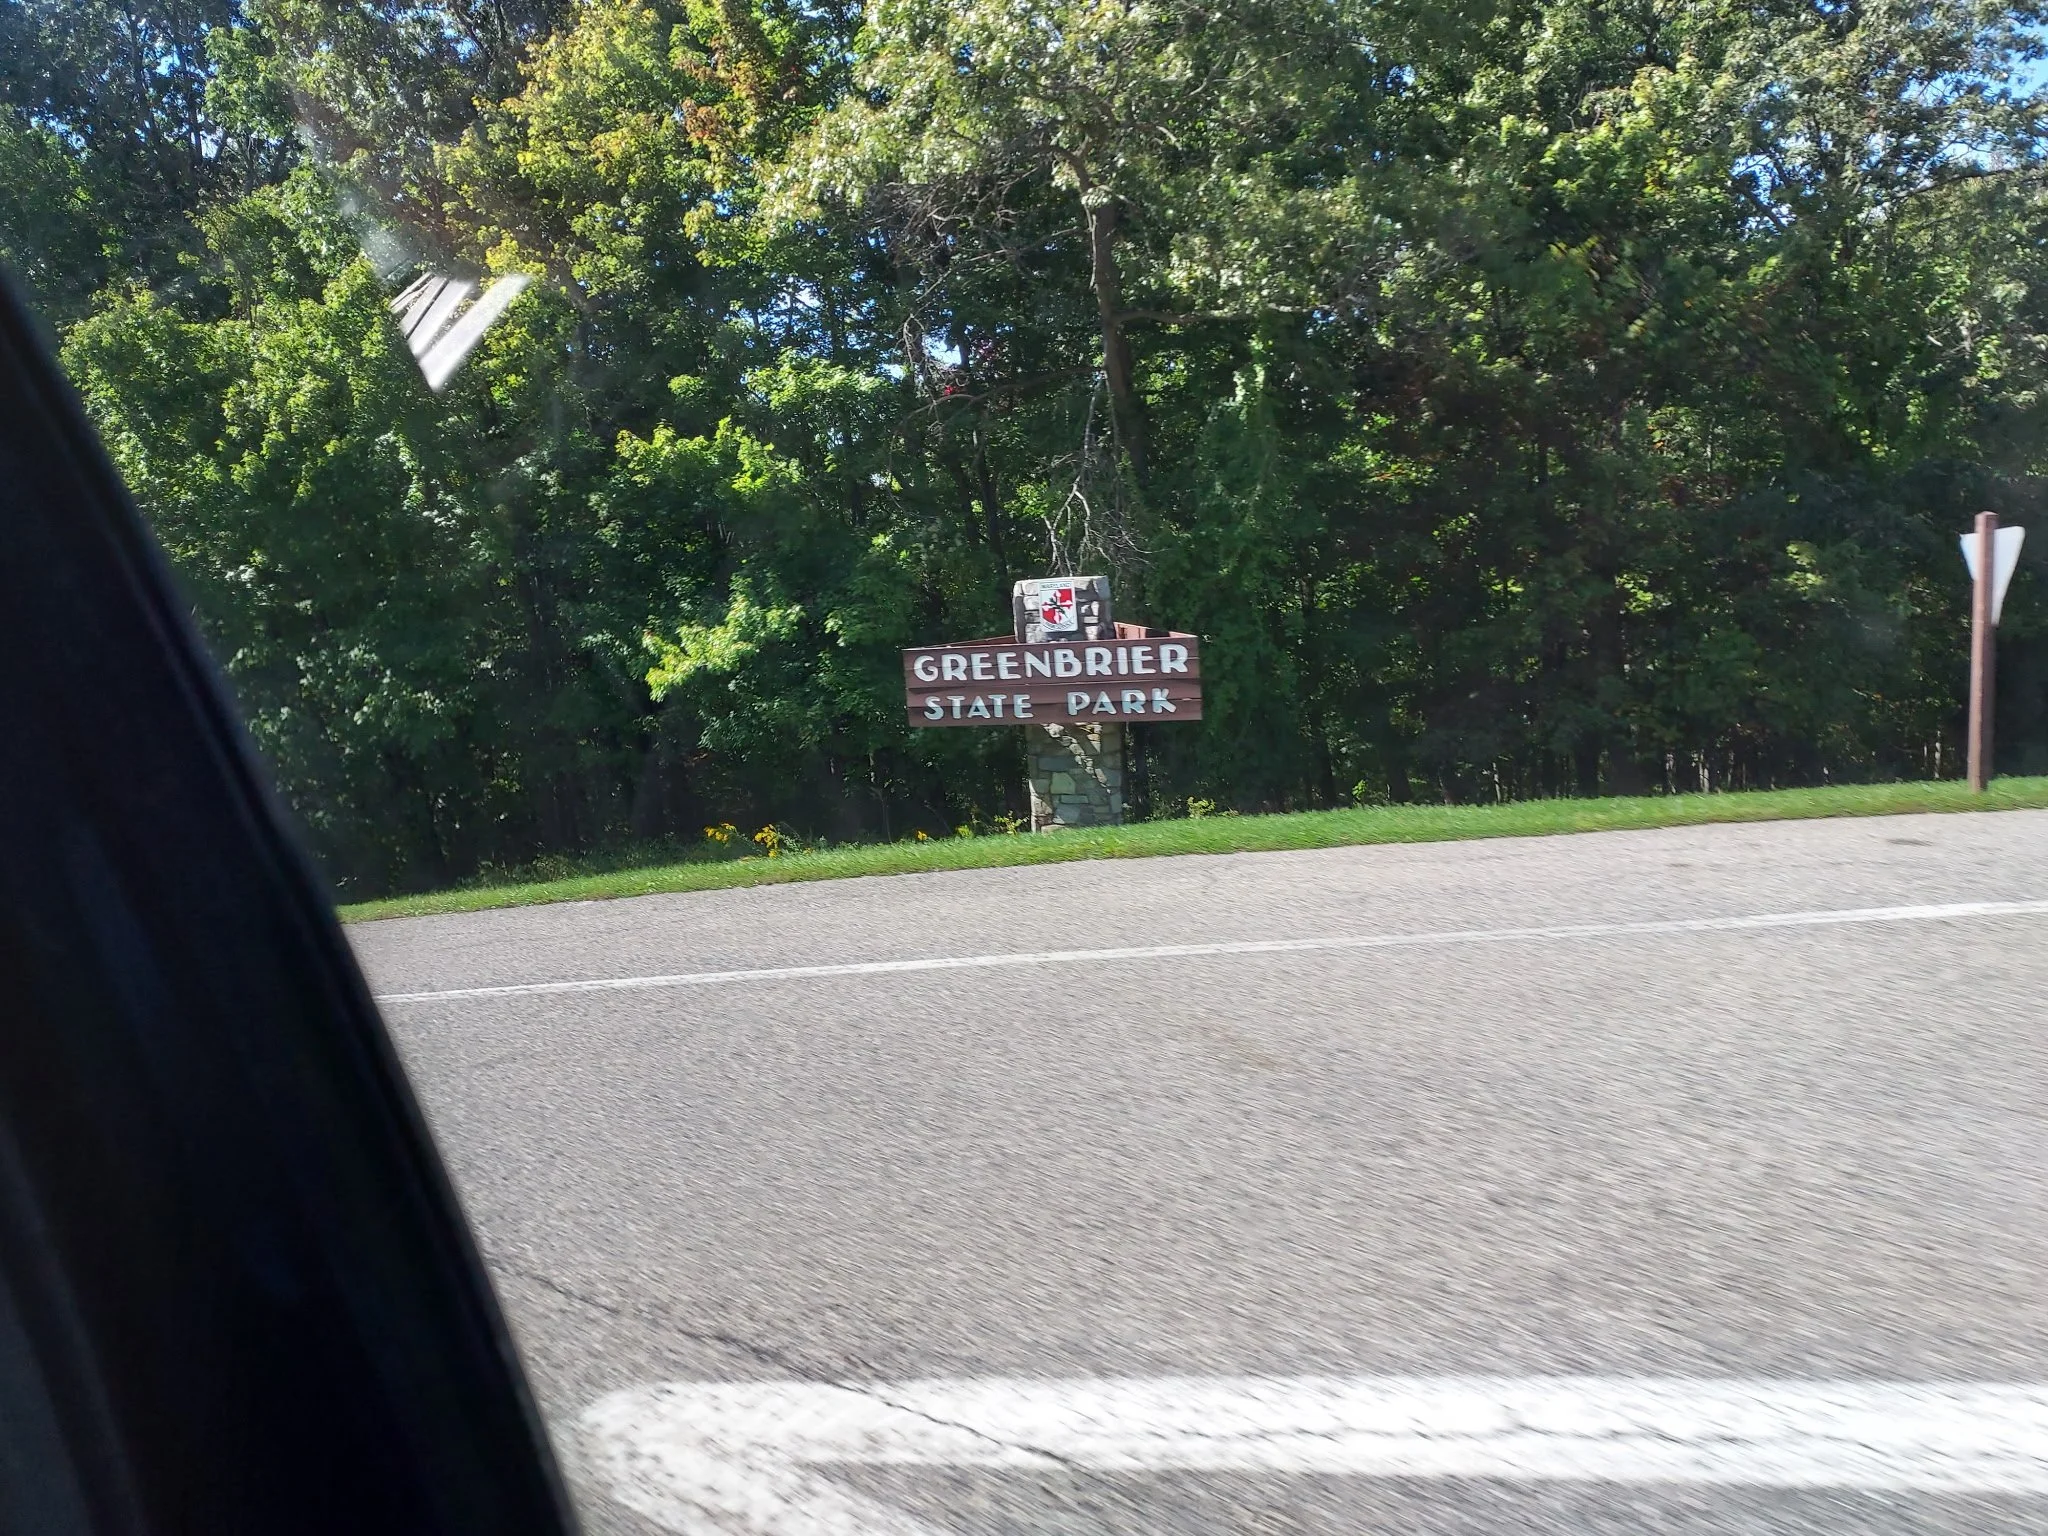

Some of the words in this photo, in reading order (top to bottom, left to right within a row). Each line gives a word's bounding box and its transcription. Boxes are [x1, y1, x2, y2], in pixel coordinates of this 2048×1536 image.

[913, 643, 1189, 682] GREENBRIER
[923, 694, 1034, 720] STATE
[1067, 688, 1177, 716] PARK
